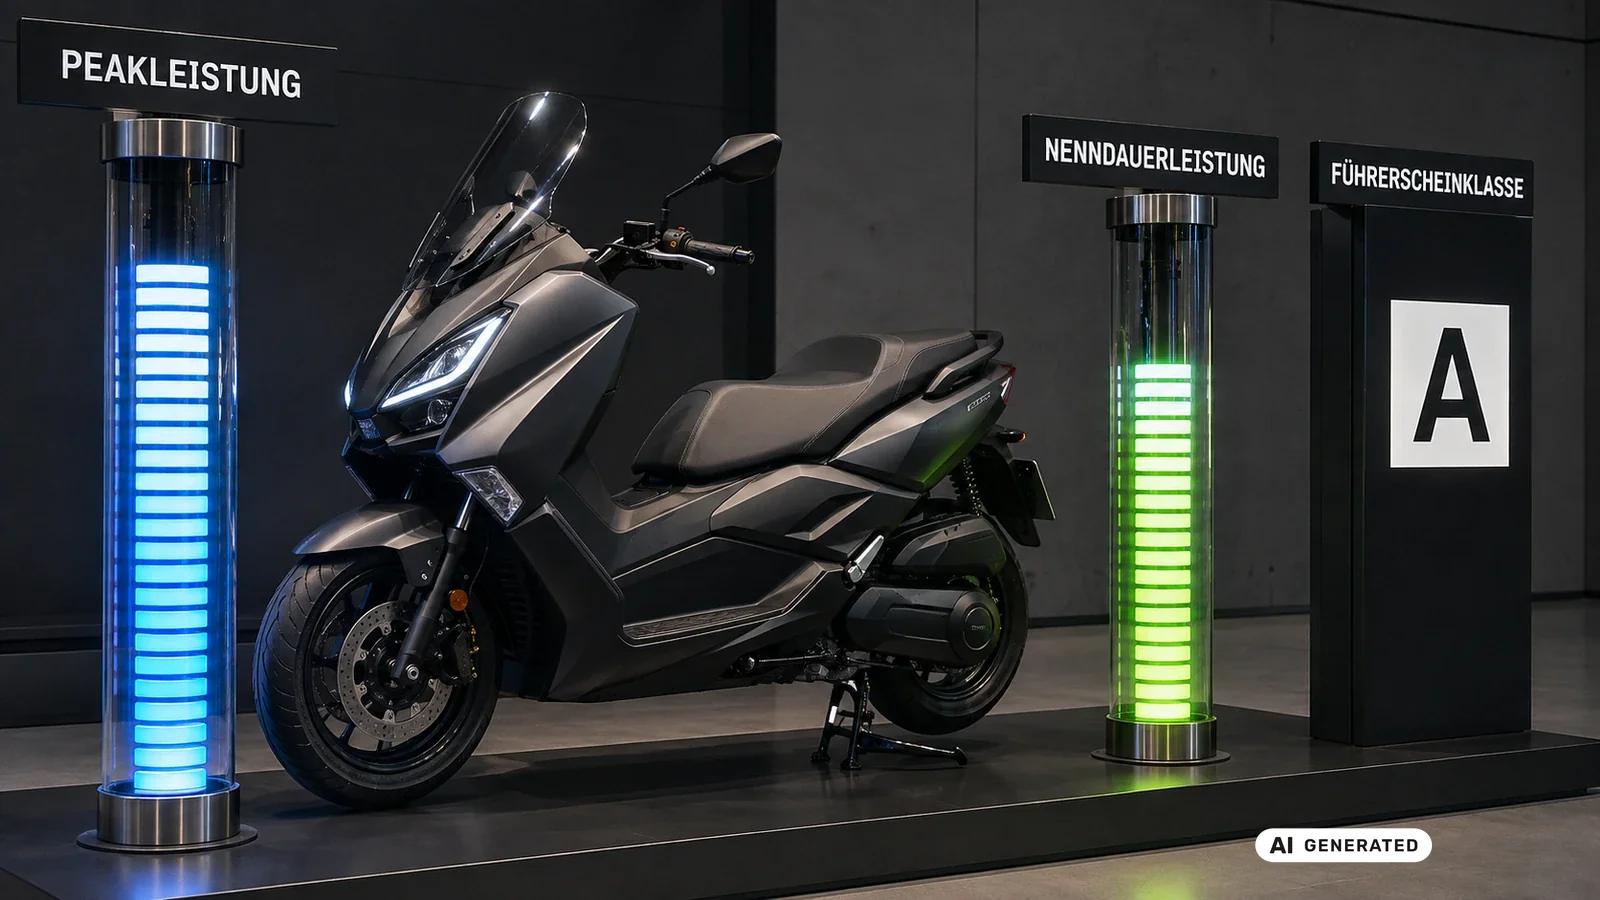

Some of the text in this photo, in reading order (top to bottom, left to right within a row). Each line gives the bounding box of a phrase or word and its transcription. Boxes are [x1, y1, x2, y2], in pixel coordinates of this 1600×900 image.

[61, 49, 302, 99] PEAKLEISTUNG
[1045, 137, 1266, 178] NENNDAUERLEISTUNG
[1331, 161, 1524, 199] FÜHRERSCHEINKLASSE
[1412, 327, 1491, 443] A
